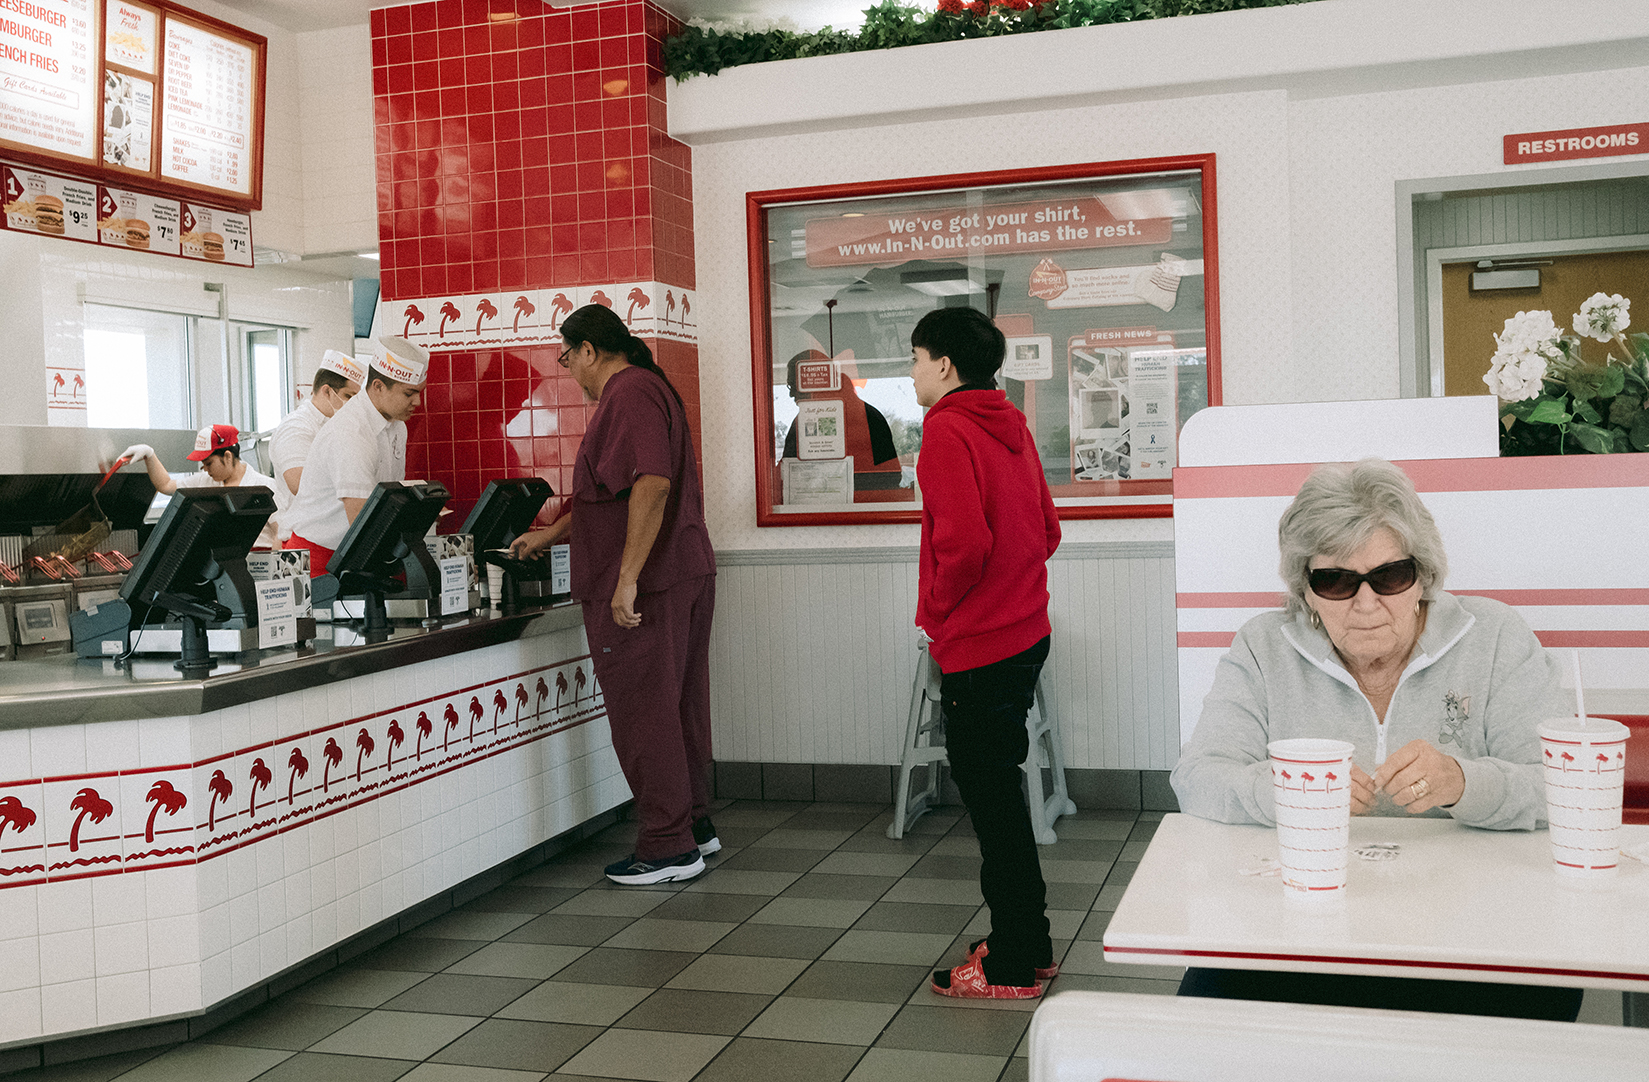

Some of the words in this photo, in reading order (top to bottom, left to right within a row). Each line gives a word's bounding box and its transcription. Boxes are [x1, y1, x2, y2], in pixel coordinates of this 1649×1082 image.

[119, 7, 141, 21] Always
[121, 18, 139, 31] Fresh
[168, 41, 180, 51] COKE
[168, 50, 178, 58] DIET
[179, 54, 191, 63] COKE
[30, 53, 58, 74] FRIES
[168, 59, 183, 69] SEVEN
[176, 69, 192, 80] PEPPER
[4, 77, 17, 89] Gift
[19, 81, 37, 92] Cards
[39, 87, 66, 100] Available
[168, 76, 180, 85] ROOT
[181, 79, 192, 89] BEER
[168, 85, 178, 94] ICED
[180, 88, 188, 96] TEA
[168, 94, 178, 102] PINK
[179, 96, 202, 109] LEMONADE
[168, 103, 191, 115] LEMONADE
[173, 137, 190, 148] SHAKES
[1517, 133, 1640, 156] RESTROOMS
[173, 146, 184, 154] MILK
[182, 157, 197, 166] COCOA
[172, 164, 188, 173] COFFEE
[8, 177, 18, 195] 1
[64, 186, 93, 196] Double-Double,
[102, 196, 111, 213] 2
[184, 212, 191, 227] 3
[888, 216, 943, 234] We've
[949, 213, 980, 233] got
[986, 211, 1028, 230] your
[1034, 205, 1086, 224] shirt,
[838, 233, 1010, 257] www.In-N-Out.com
[1016, 228, 1050, 244] has
[1056, 225, 1089, 241] the
[1095, 221, 1142, 239] rest.
[1091, 332, 1121, 340] FRESH
[1124, 330, 1152, 338] NEWS
[335, 363, 361, 379] IN-N-OUT
[379, 360, 412, 378] IN-N-OUT
